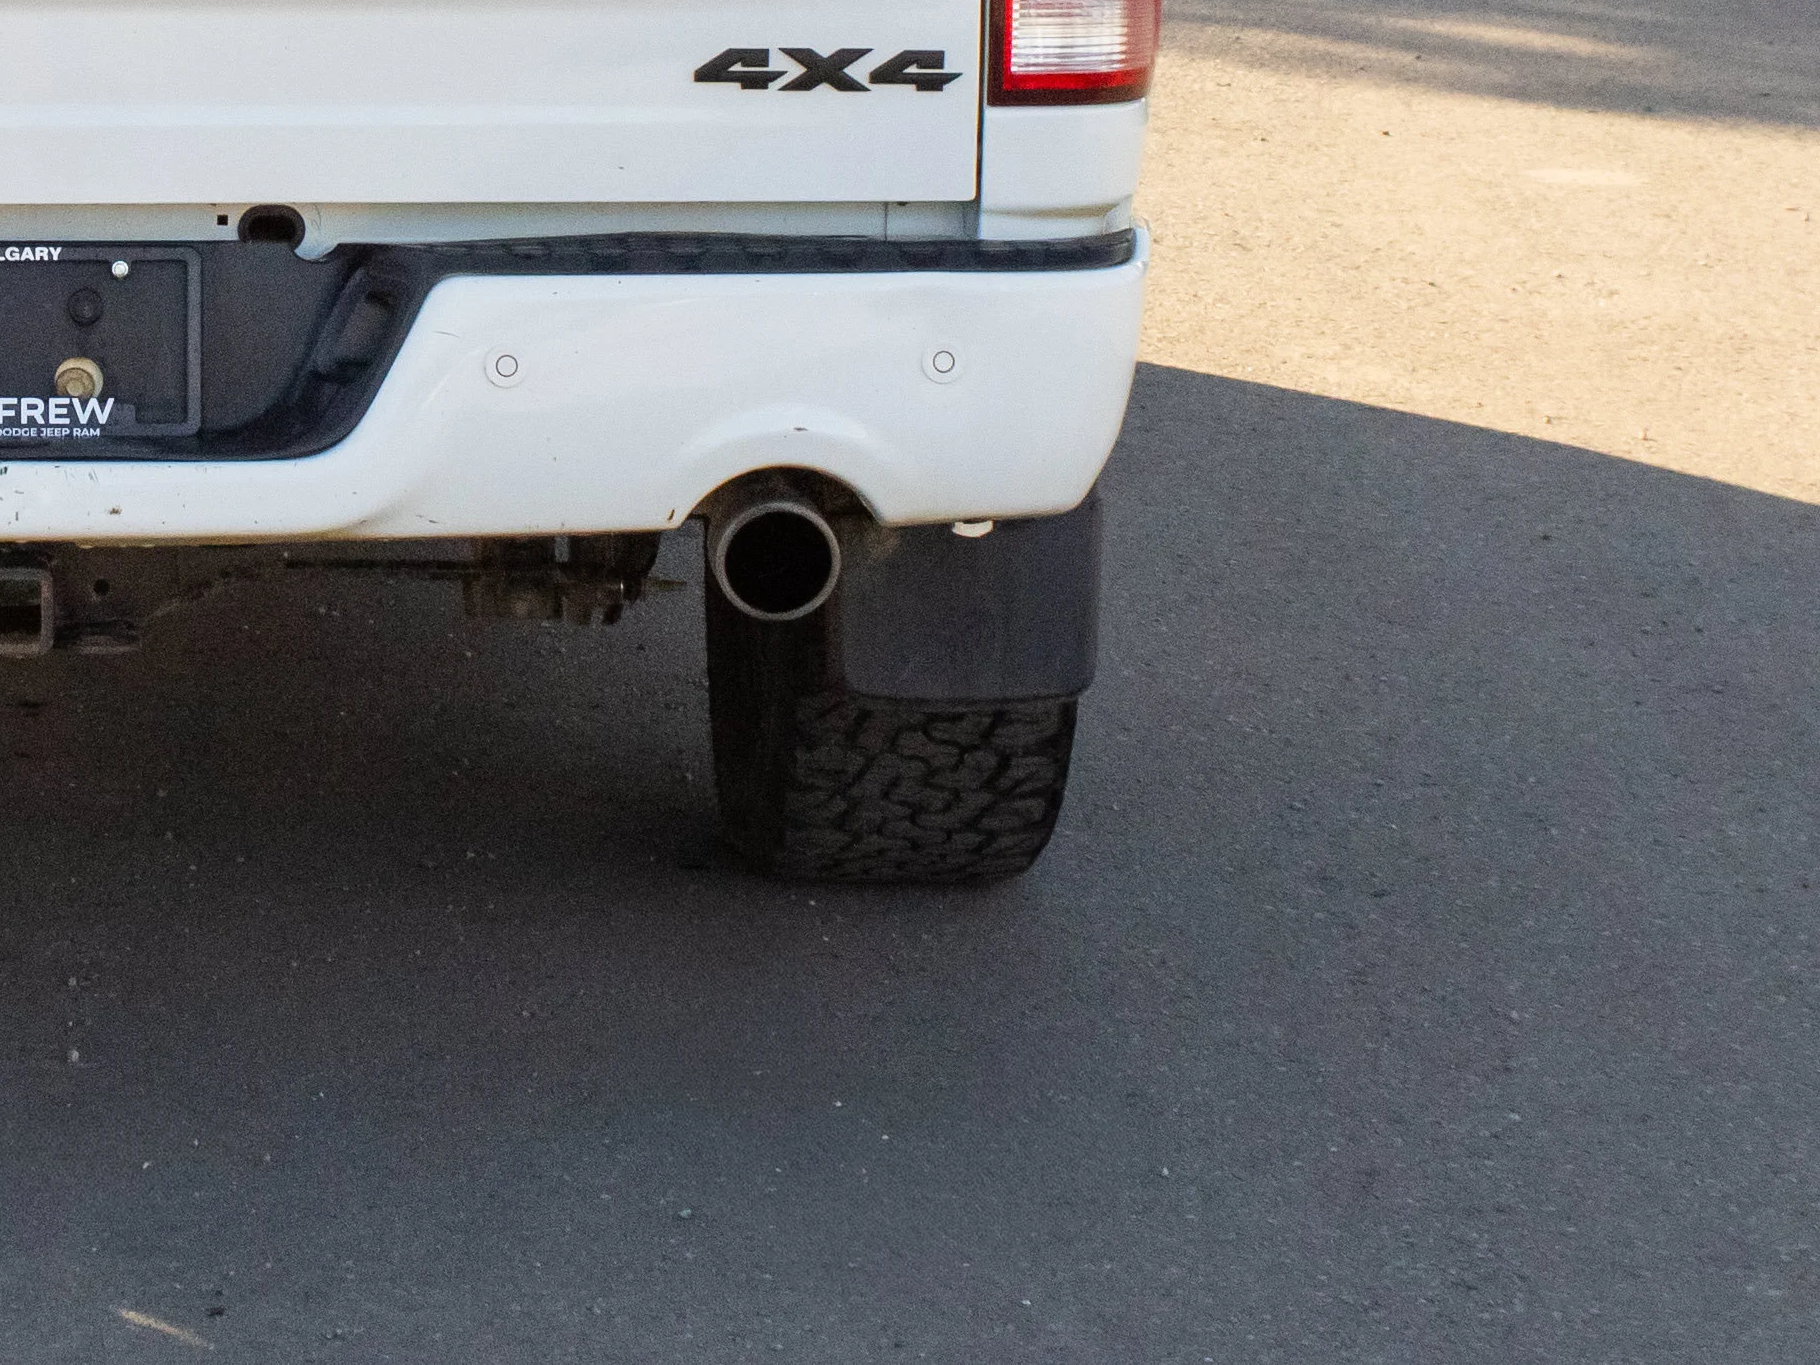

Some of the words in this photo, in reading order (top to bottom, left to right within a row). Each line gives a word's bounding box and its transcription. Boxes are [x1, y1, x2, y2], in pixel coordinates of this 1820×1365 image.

[693, 47, 964, 92] 4X4
[39, 427, 70, 437] JEEP
[72, 427, 101, 437] RAM
